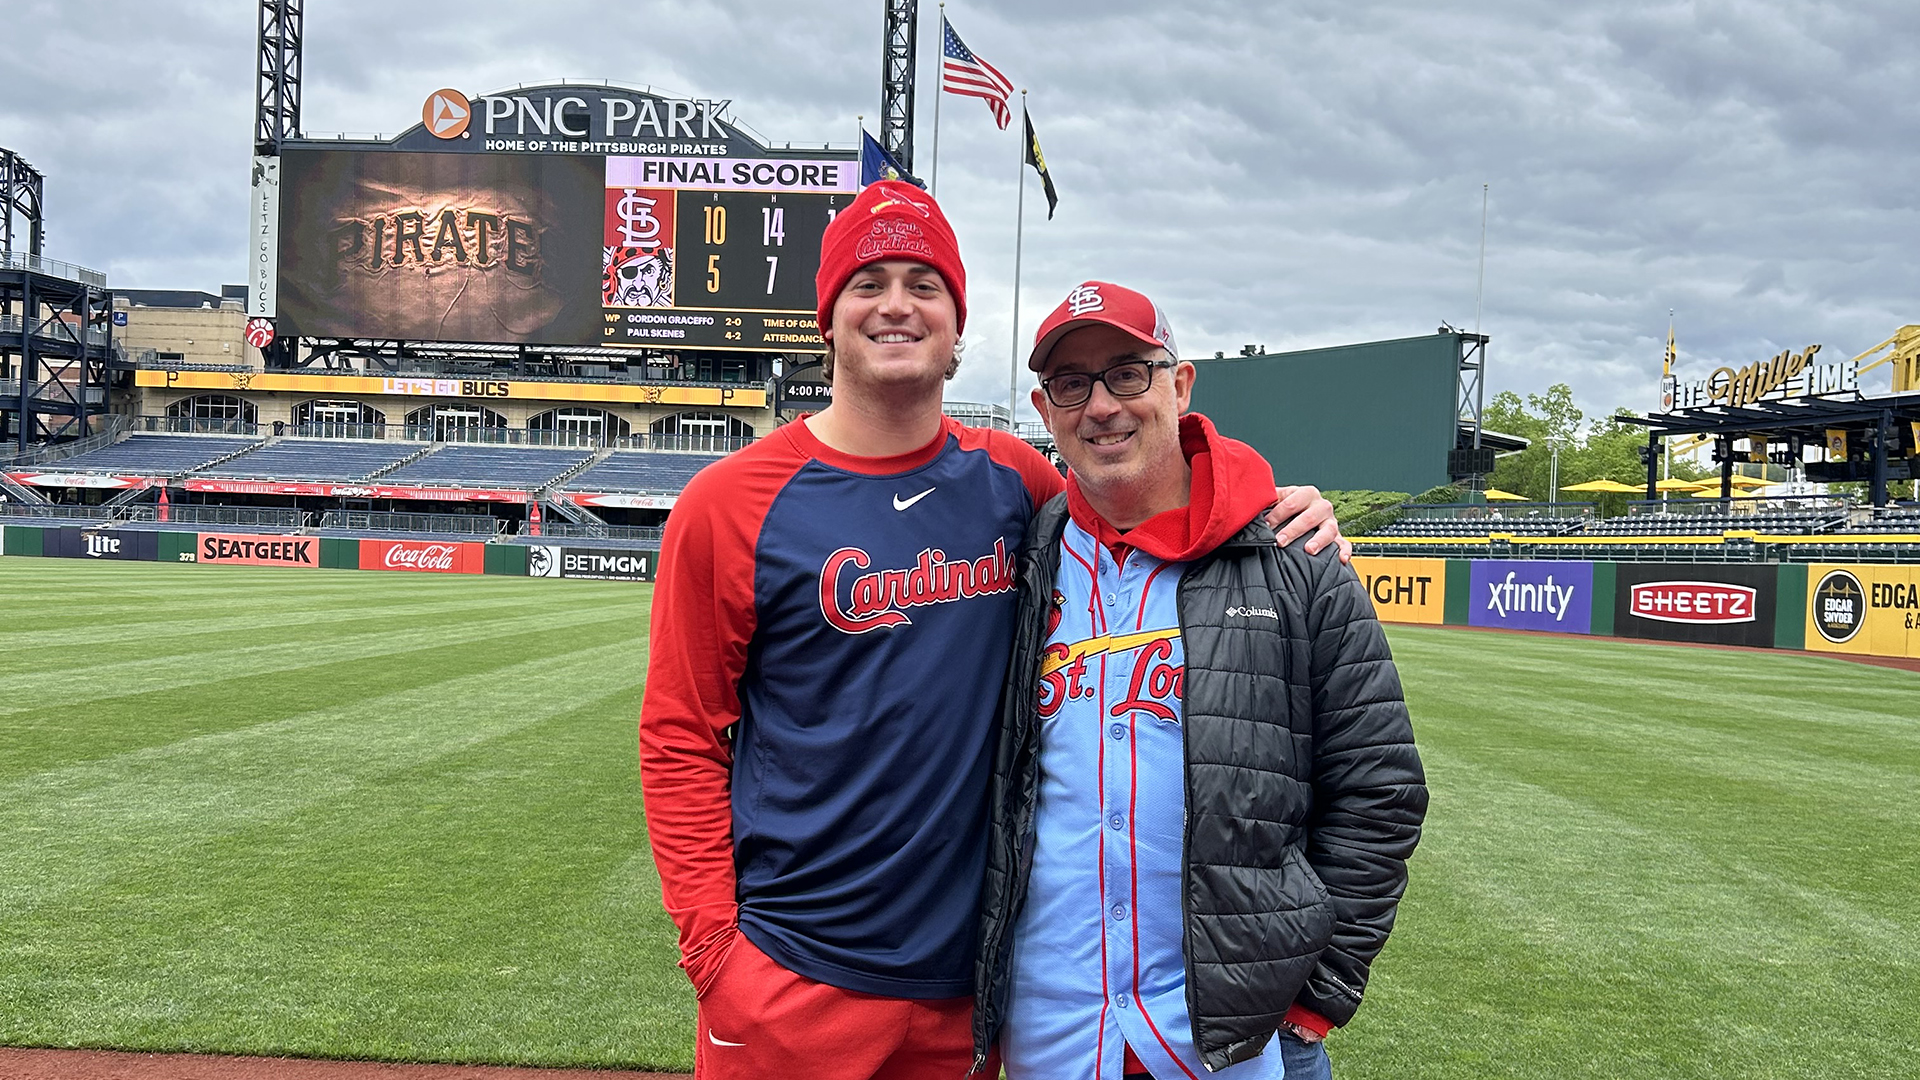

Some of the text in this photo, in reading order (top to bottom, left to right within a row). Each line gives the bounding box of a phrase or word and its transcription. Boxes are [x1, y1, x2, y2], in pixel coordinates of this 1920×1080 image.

[480, 96, 732, 139] PNC PARK
[486, 140, 728, 155] HOME OF THE PITTSBURGH PIRATES
[642, 161, 838, 186] FINAL SCORE
[713, 193, 835, 204] R H E
[703, 206, 785, 246] 10 14
[259, 241, 269, 263] GO
[706, 255, 778, 295] 5 7
[258, 269, 268, 313] BUCS
[604, 313, 621, 323] WP
[627, 314, 667, 325] GORDON
[668, 316, 715, 326] GRACEFFO
[725, 317, 742, 327] 2-0
[763, 318, 785, 328] TIME
[785, 319, 797, 328] OF
[604, 327, 825, 344] LP PAUL SKENES 4-2 ATTENDANCE
[383, 377, 510, 397] LET'S GO BUCS
[1679, 343, 1860, 409] IT'S Miller TIME
[788, 385, 833, 397] 4:00 PM
[86, 533, 121, 558] Lite
[203, 537, 312, 564] SEATGEEK
[385, 543, 458, 570] Coca-Cola
[564, 554, 647, 574] BETMGM
[819, 536, 1018, 635] Cardinals
[1487, 571, 1575, 621] xfinity
[1871, 582, 1919, 610] EDGA
[1638, 590, 1748, 615] SHEETZ
[1824, 597, 1853, 612] EDGAR
[1823, 611, 1854, 624] SNYDER
[1904, 612, 1914, 630] &
[1037, 642, 1096, 719] St.
